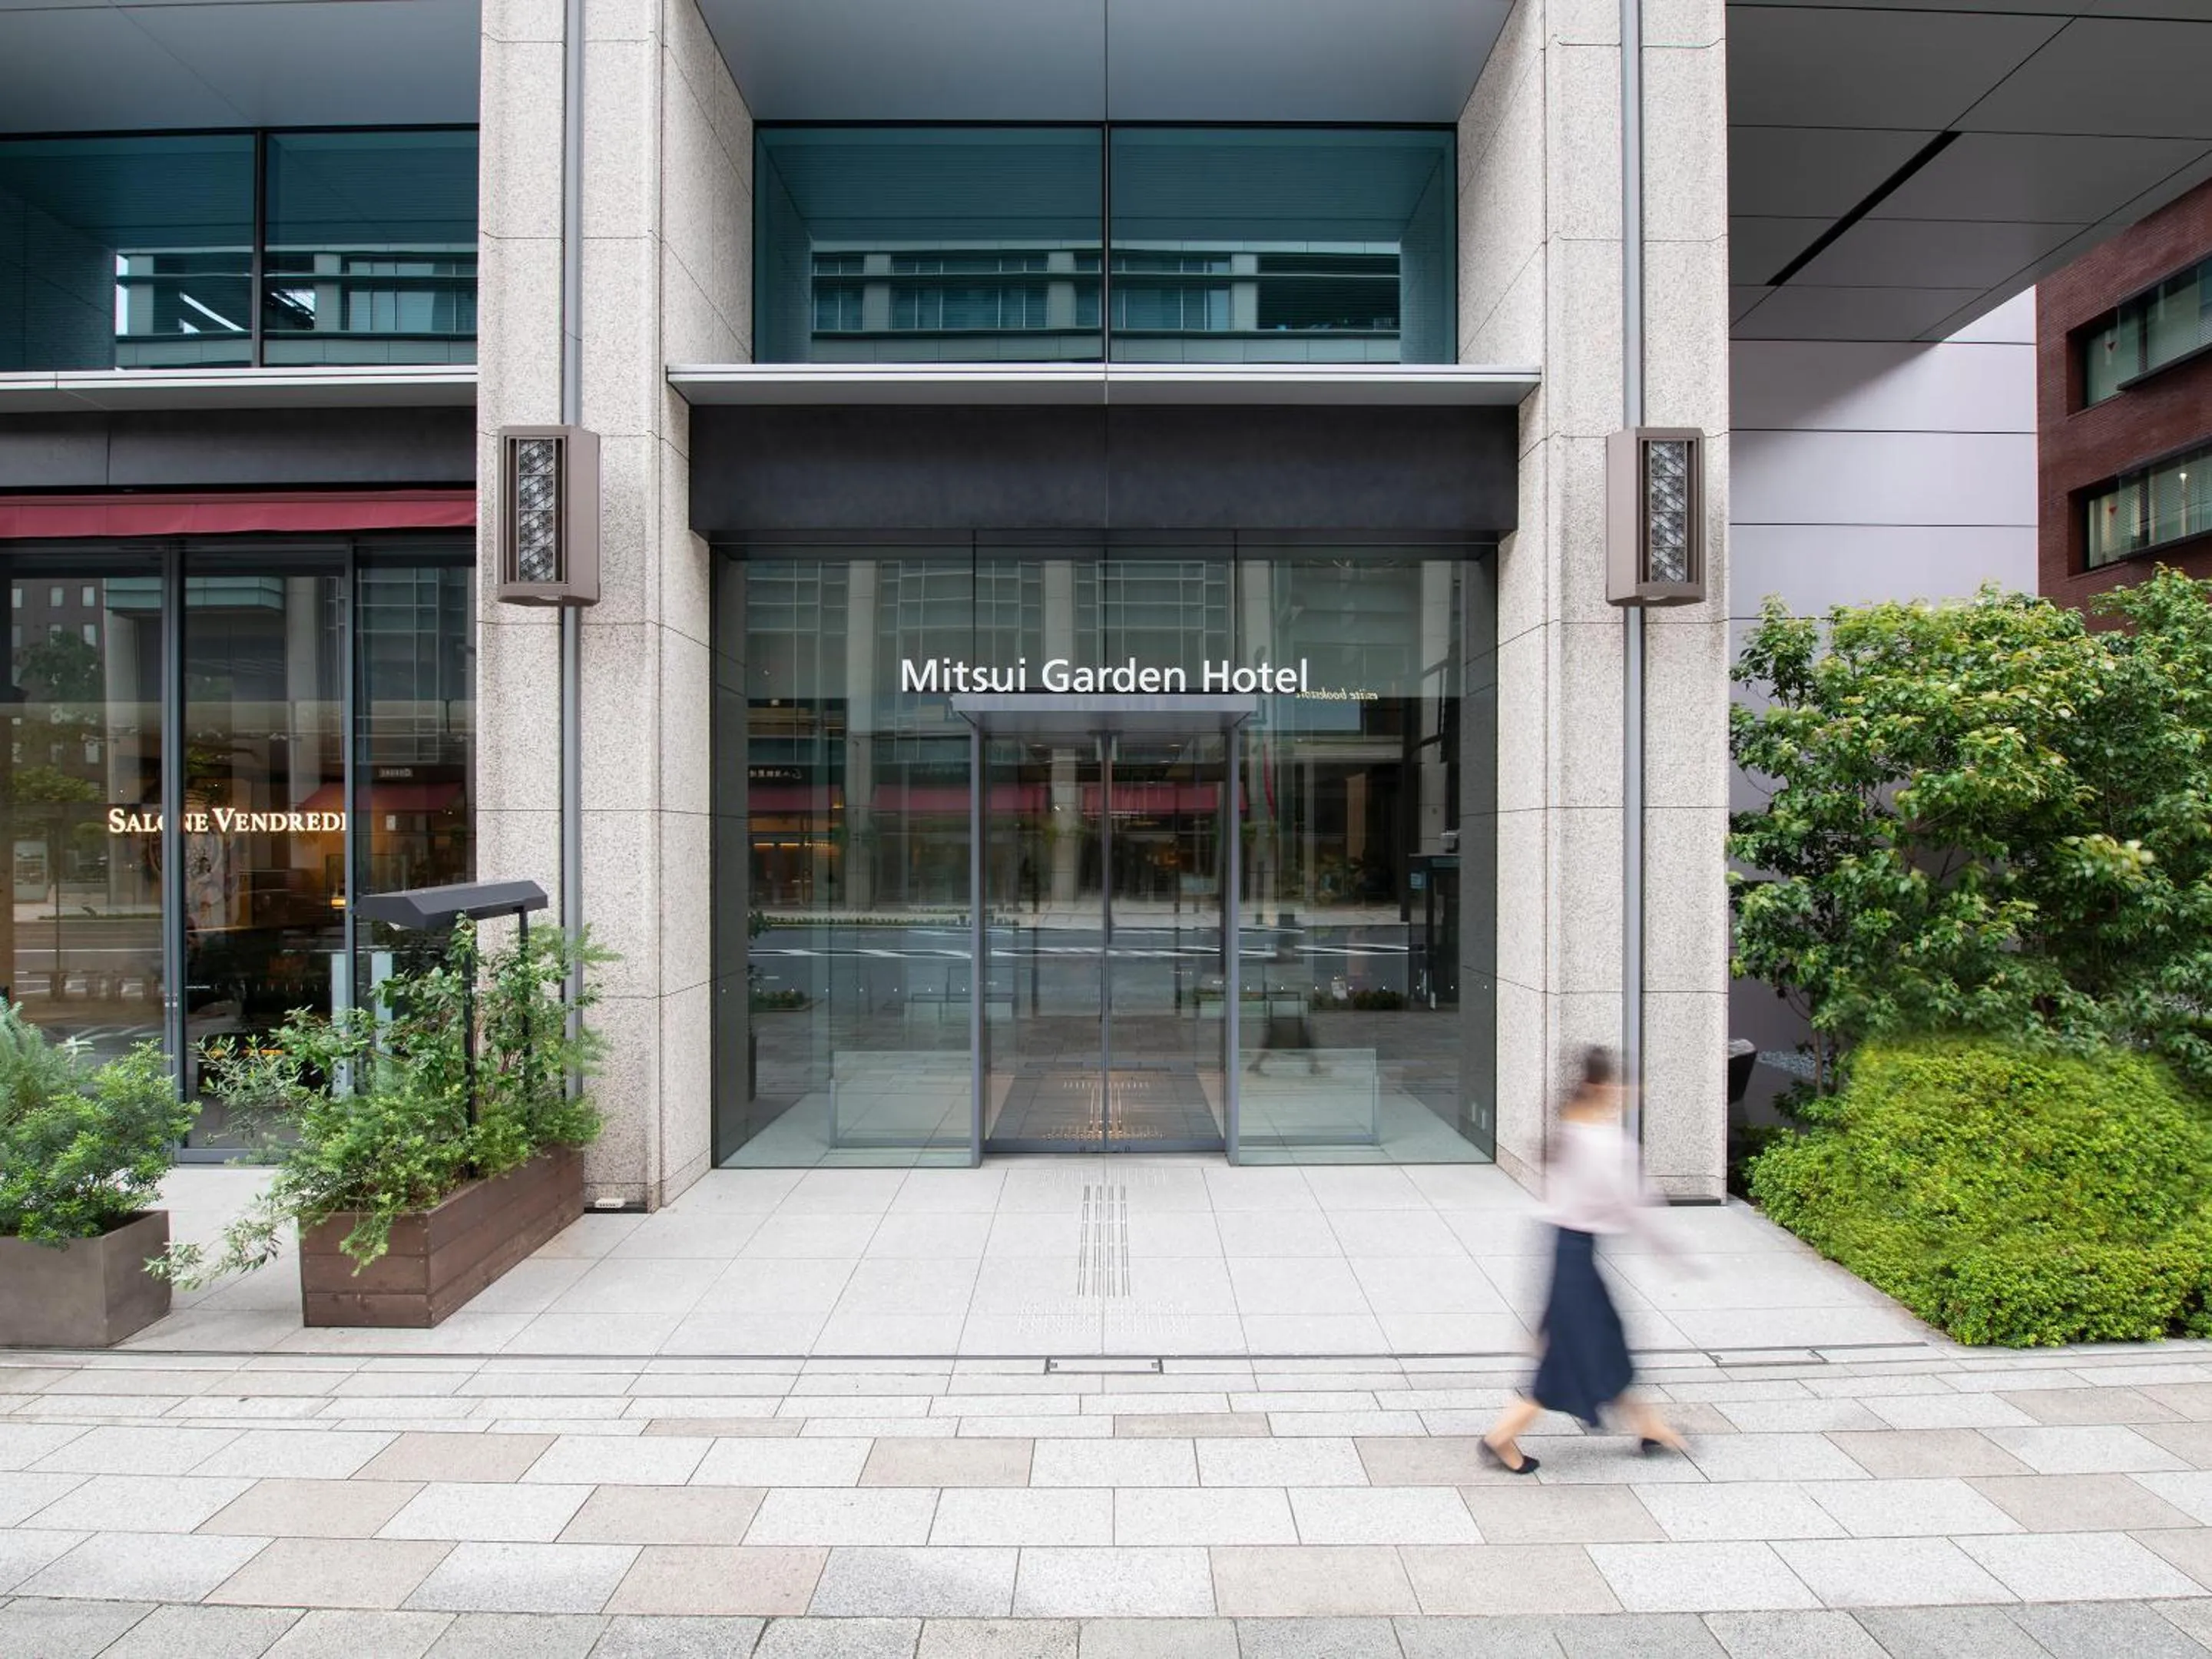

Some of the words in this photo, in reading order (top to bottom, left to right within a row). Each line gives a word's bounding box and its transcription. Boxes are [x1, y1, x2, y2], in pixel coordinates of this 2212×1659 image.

[901, 660, 1026, 693] Mitsui
[1041, 658, 1186, 693] Garden
[1202, 657, 1309, 693] Hotel
